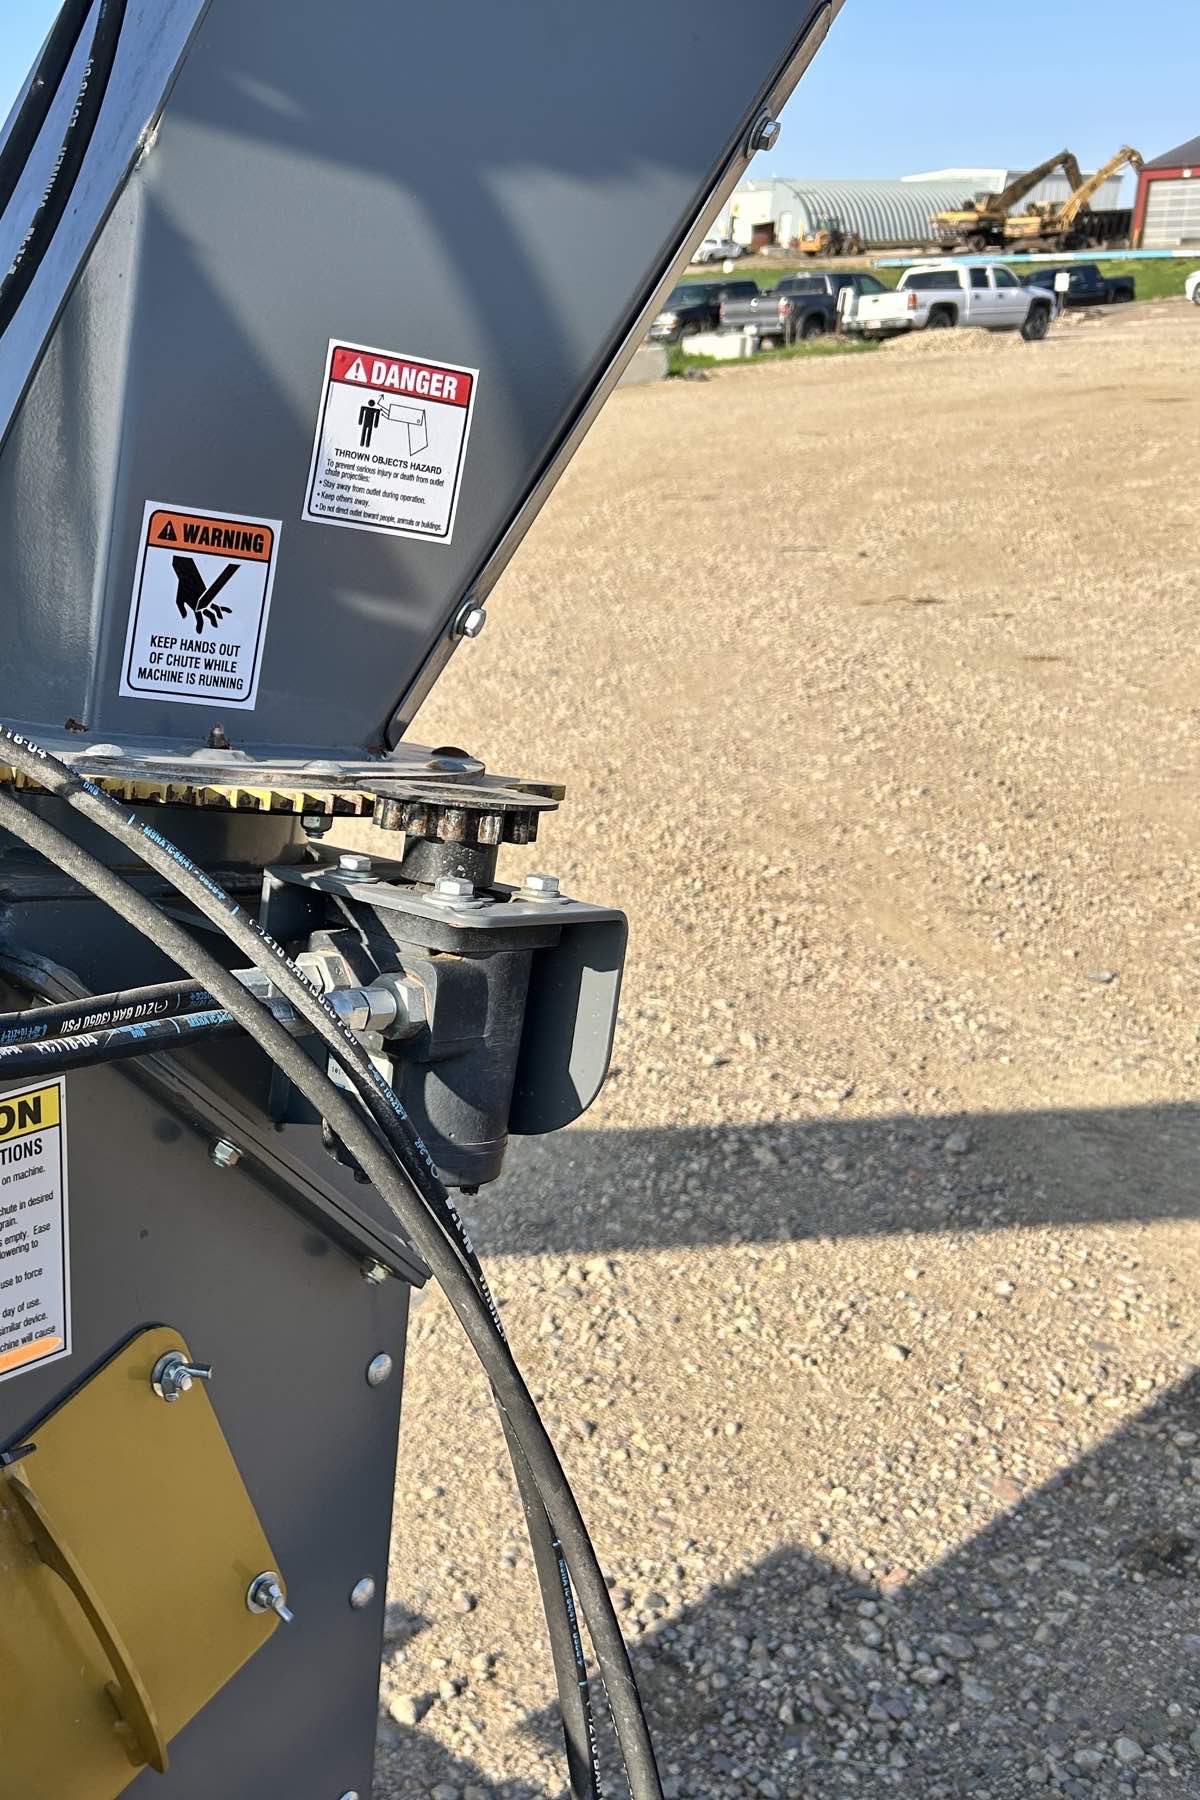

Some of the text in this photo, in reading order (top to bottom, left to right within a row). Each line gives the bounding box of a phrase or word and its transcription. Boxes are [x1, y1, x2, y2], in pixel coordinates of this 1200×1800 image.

[370, 360, 457, 400] DANGER
[334, 447, 442, 475] THROWN OBJECTS HAZARD
[324, 467, 340, 477] chute
[326, 458, 334, 467] To
[334, 461, 355, 471] prevent
[355, 465, 376, 474] serious
[376, 467, 392, 479] injury
[399, 471, 415, 481] death
[415, 474, 428, 483] from
[429, 478, 444, 486] outlet
[320, 490, 369, 508] Keep others away.
[322, 478, 425, 504] Stay away from outlet during operation.
[318, 502, 326, 511] Do
[335, 506, 349, 515] direct
[348, 509, 362, 517] outlet
[362, 510, 379, 520] toward
[378, 514, 395, 523] people,
[396, 517, 414, 526] animals
[420, 520, 441, 531] buildings.
[182, 522, 264, 553] WARNING
[149, 634, 240, 657] KEEP HANDS OUT
[148, 651, 237, 673] OF CHUTE WHILE
[137, 666, 243, 690] MACHINE IS RUNNING
[111, 1006, 135, 1021] BAR
[1, 1175, 11, 1185] on
[12, 1165, 45, 1182] machine.
[18, 1200, 26, 1210] in
[27, 1190, 53, 1207] desired
[32, 1222, 51, 1235] Ease
[30, 1239, 38, 1248] to
[0, 1277, 13, 1289] use
[14, 1274, 22, 1284] to
[23, 1267, 42, 1280] force
[1, 1306, 15, 1318] day
[16, 1301, 24, 1312] of
[26, 1298, 40, 1309] use.
[22, 1312, 48, 1327] device.
[20, 1331, 33, 1344] will
[34, 1324, 55, 1339] cause
